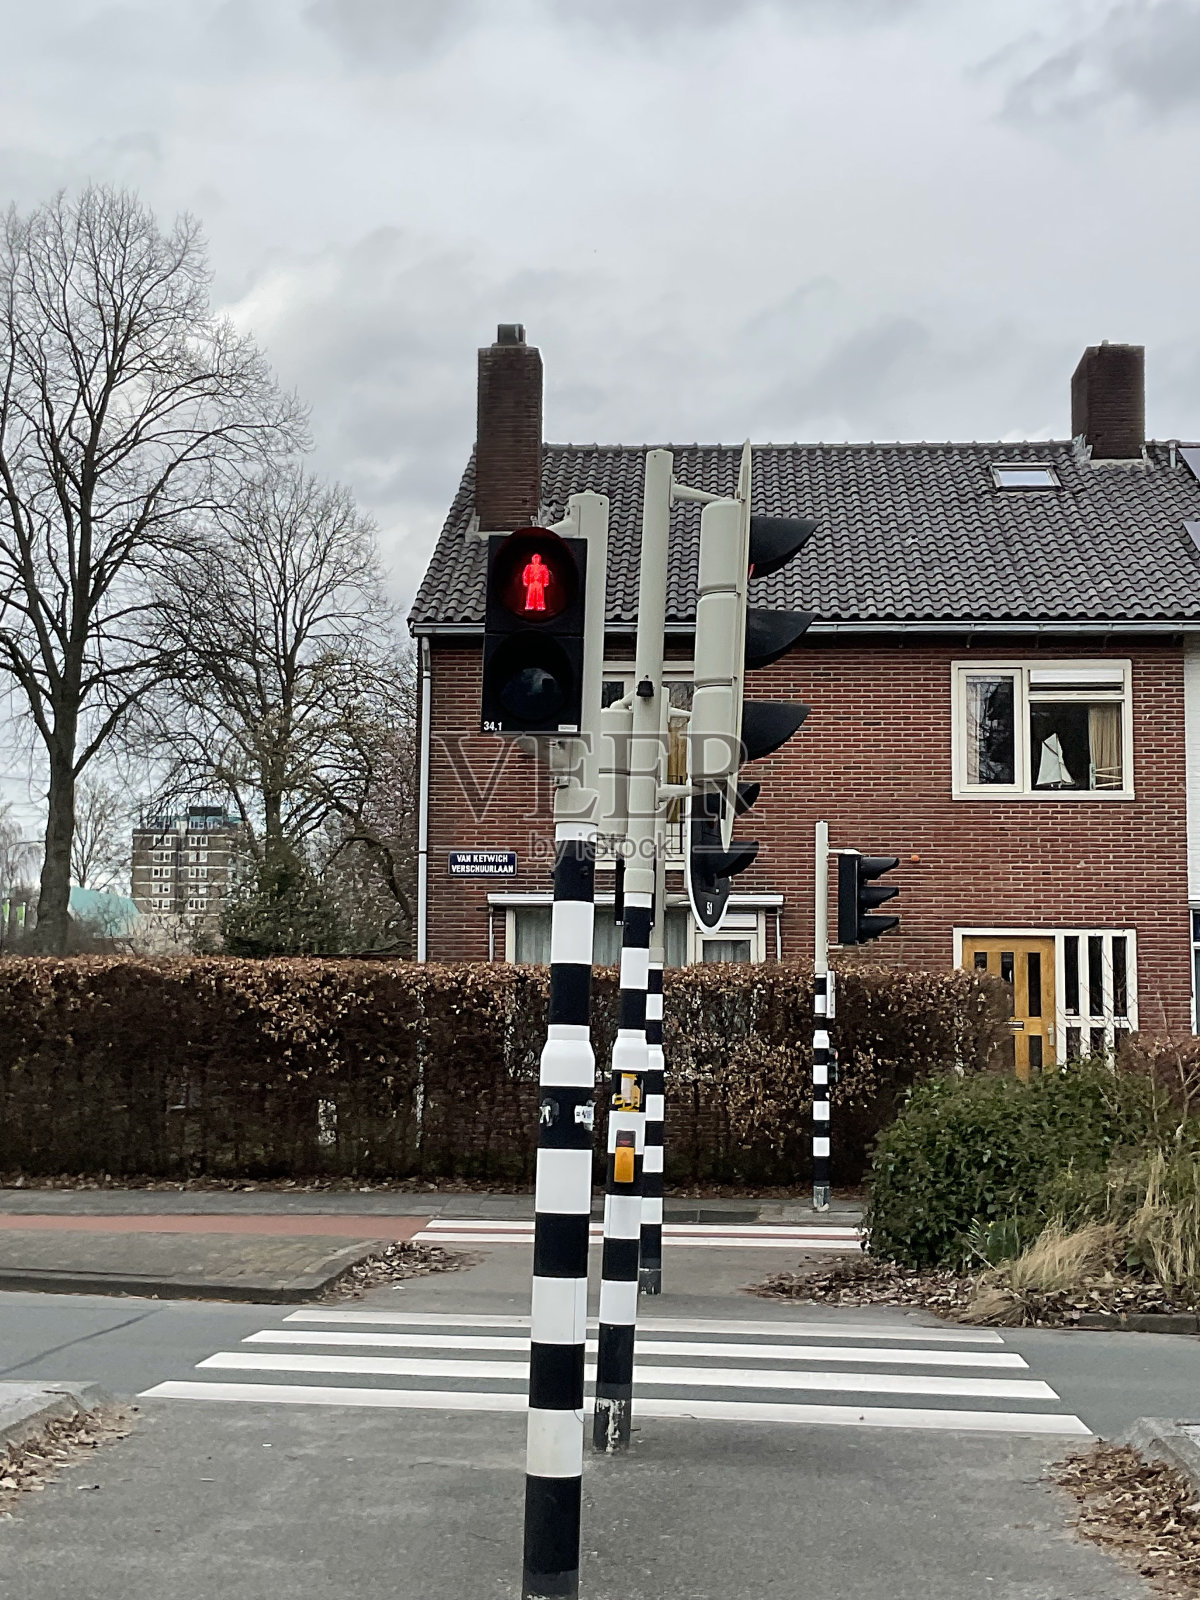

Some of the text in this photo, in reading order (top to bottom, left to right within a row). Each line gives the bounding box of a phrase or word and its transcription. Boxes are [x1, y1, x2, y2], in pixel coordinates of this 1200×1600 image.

[483, 721, 503, 731] 34.1
[456, 854, 509, 863] VAN KETWICH
[451, 864, 514, 873] VERSCHUURLAAN
